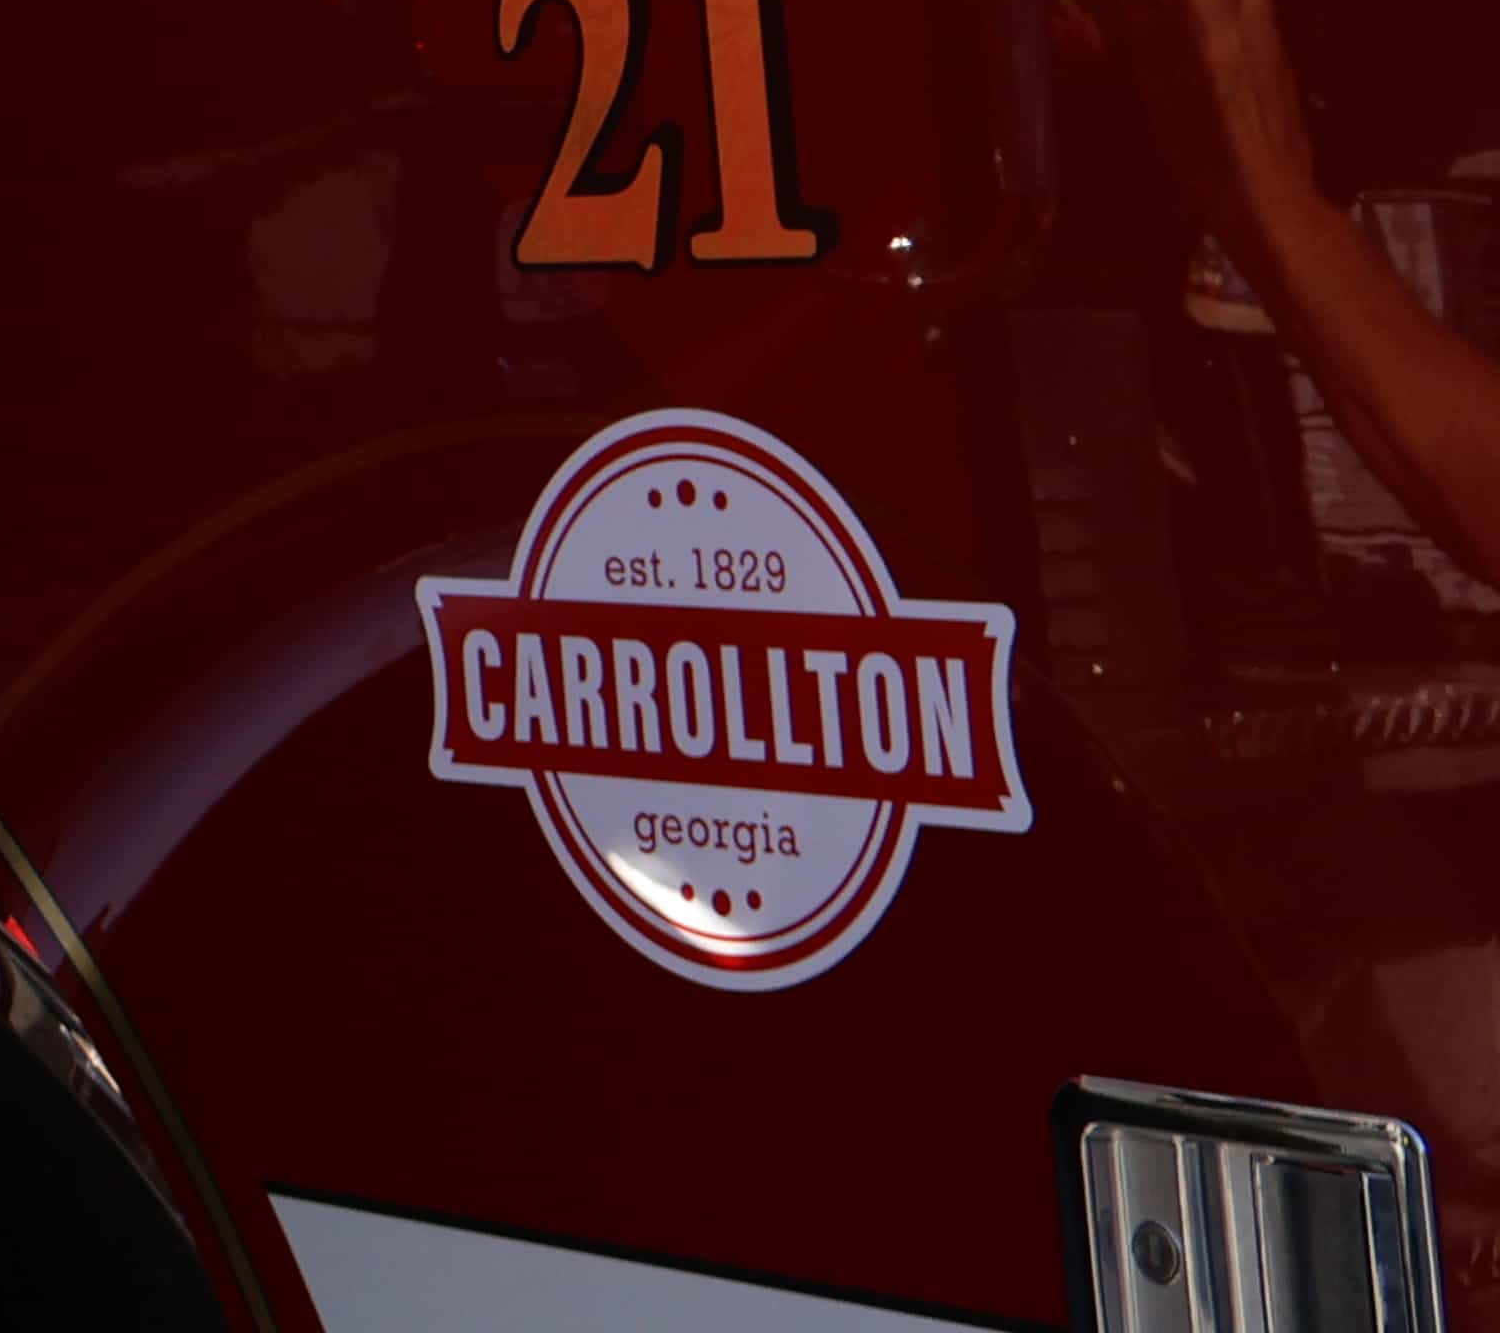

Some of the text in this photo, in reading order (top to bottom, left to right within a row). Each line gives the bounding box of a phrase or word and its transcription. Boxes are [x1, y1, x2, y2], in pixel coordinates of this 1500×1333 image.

[604, 547, 787, 595] est. 1829
[461, 627, 976, 780] CARROLLTON
[633, 810, 801, 867] georgia
